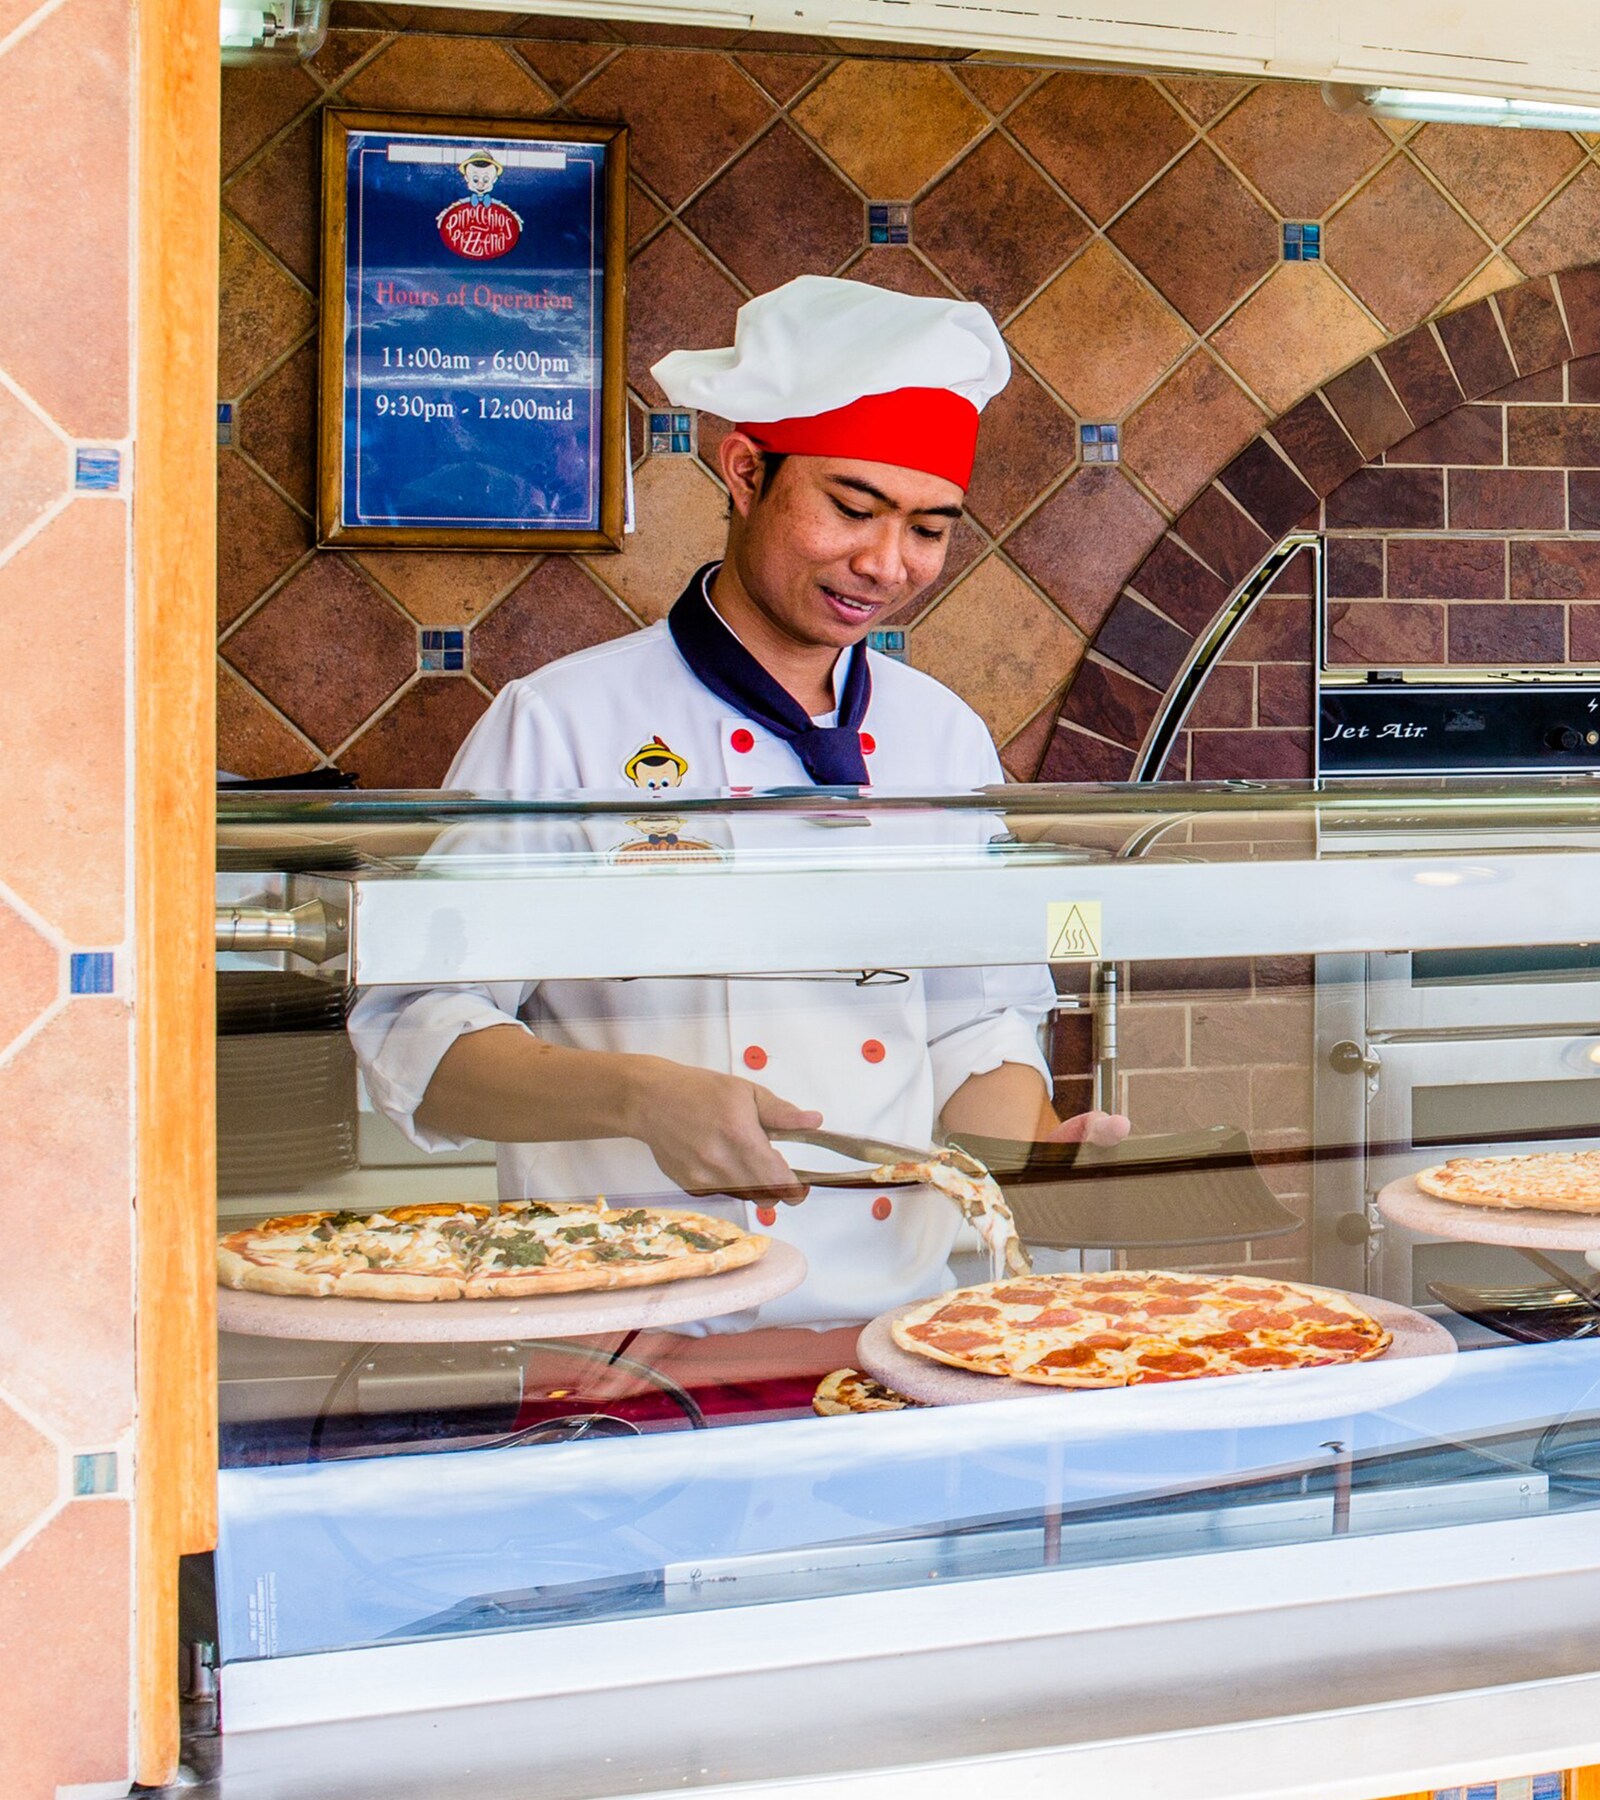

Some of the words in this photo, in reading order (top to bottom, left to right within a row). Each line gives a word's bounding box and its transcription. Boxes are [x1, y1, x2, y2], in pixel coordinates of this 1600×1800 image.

[376, 281, 440, 305] Hours
[446, 283, 468, 306] of
[473, 284, 574, 313] Operation
[381, 346, 471, 370] 11:00am
[492, 349, 570, 376] 6:00pm
[375, 394, 455, 423] 9:30pm
[478, 398, 574, 421] 12:00mid
[1323, 723, 1370, 742] Jet
